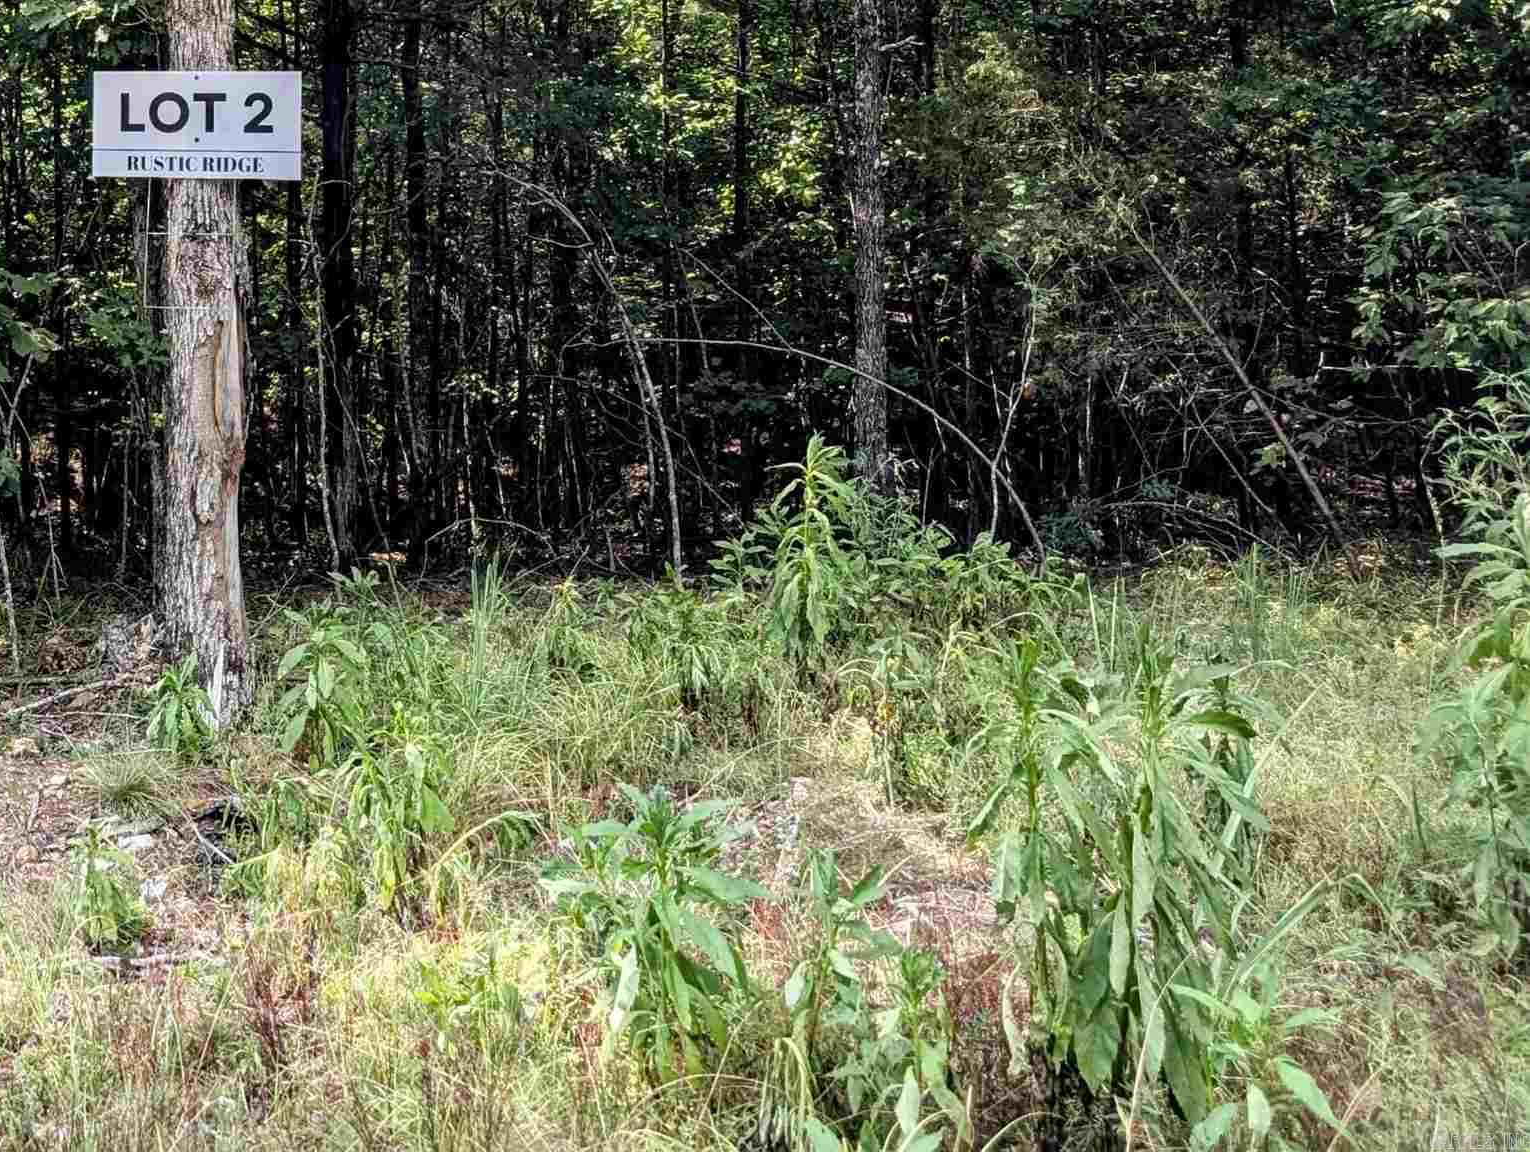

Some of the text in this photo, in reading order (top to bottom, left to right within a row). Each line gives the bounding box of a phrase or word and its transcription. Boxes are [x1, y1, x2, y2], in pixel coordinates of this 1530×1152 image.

[120, 92, 274, 134] LOT 2
[127, 155, 265, 174] RUSTIC RIDGE
